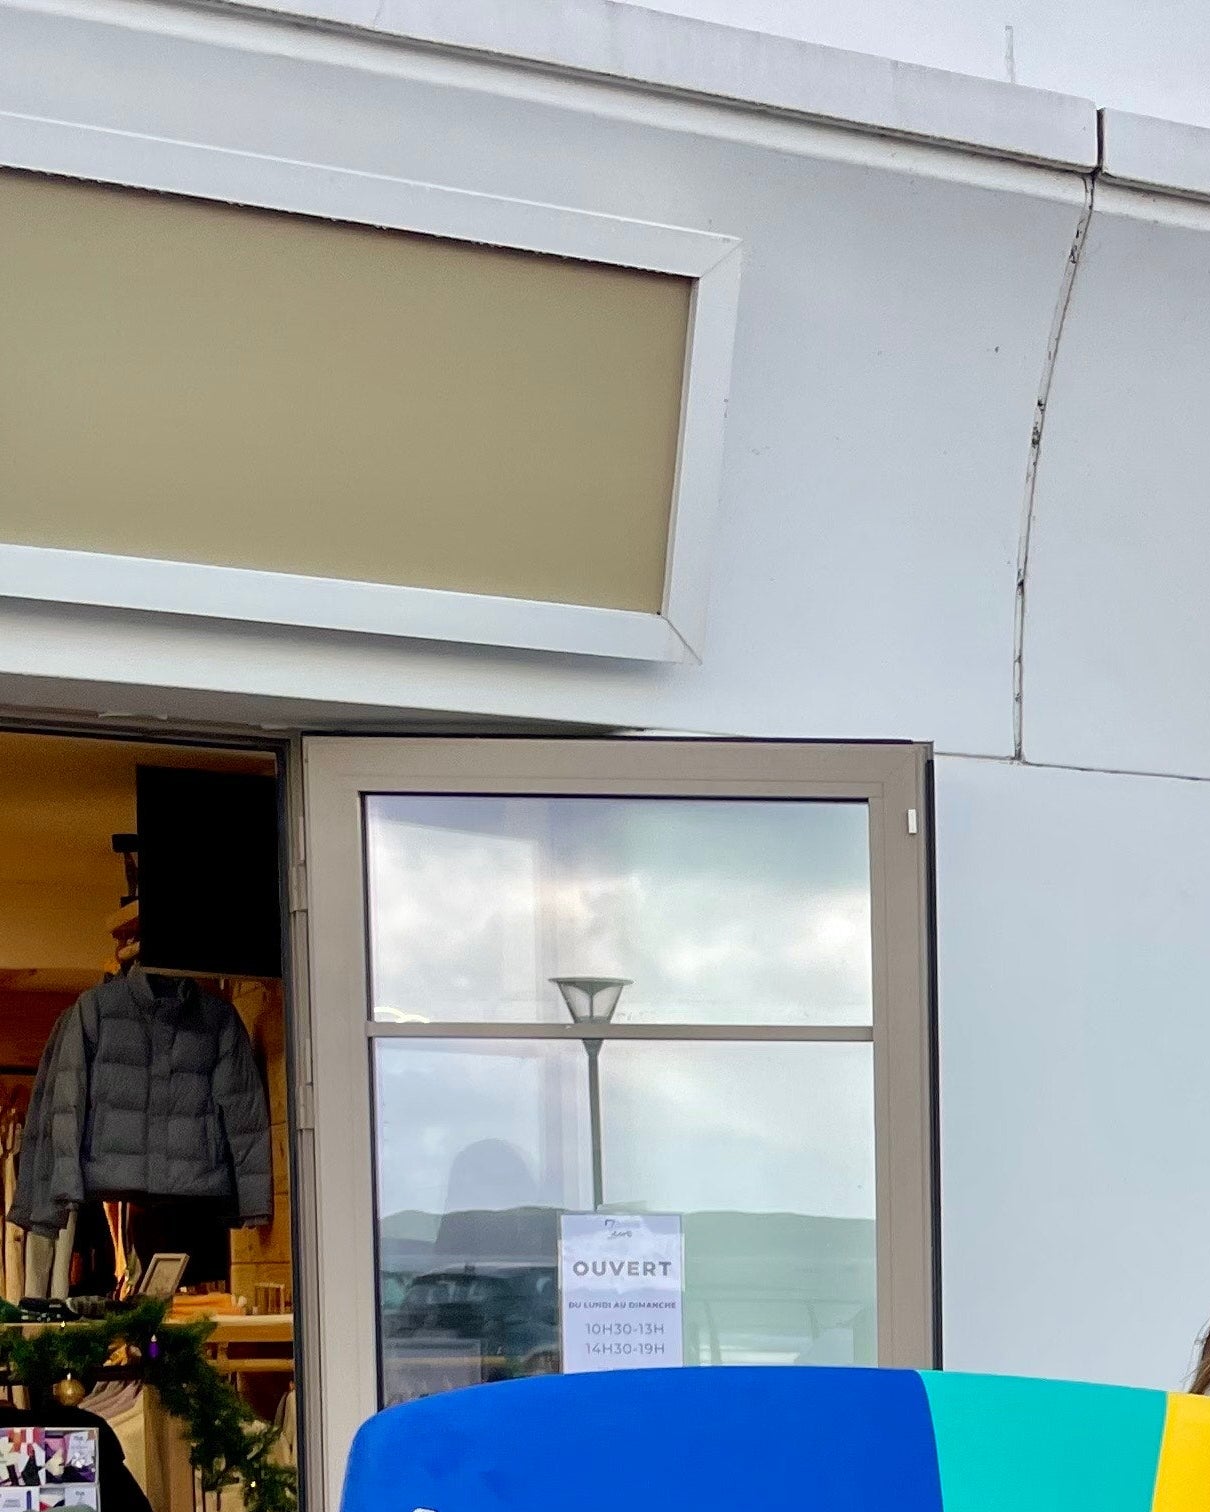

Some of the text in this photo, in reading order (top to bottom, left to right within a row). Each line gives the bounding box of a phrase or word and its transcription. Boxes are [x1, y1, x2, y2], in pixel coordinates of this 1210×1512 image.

[572, 1260, 672, 1277] OUVERT
[568, 1301, 677, 1309] DU LUNDI AU DIMANCHE
[585, 1322, 665, 1335] 10H30-13H
[585, 1342, 665, 1355] 14H30-19H
